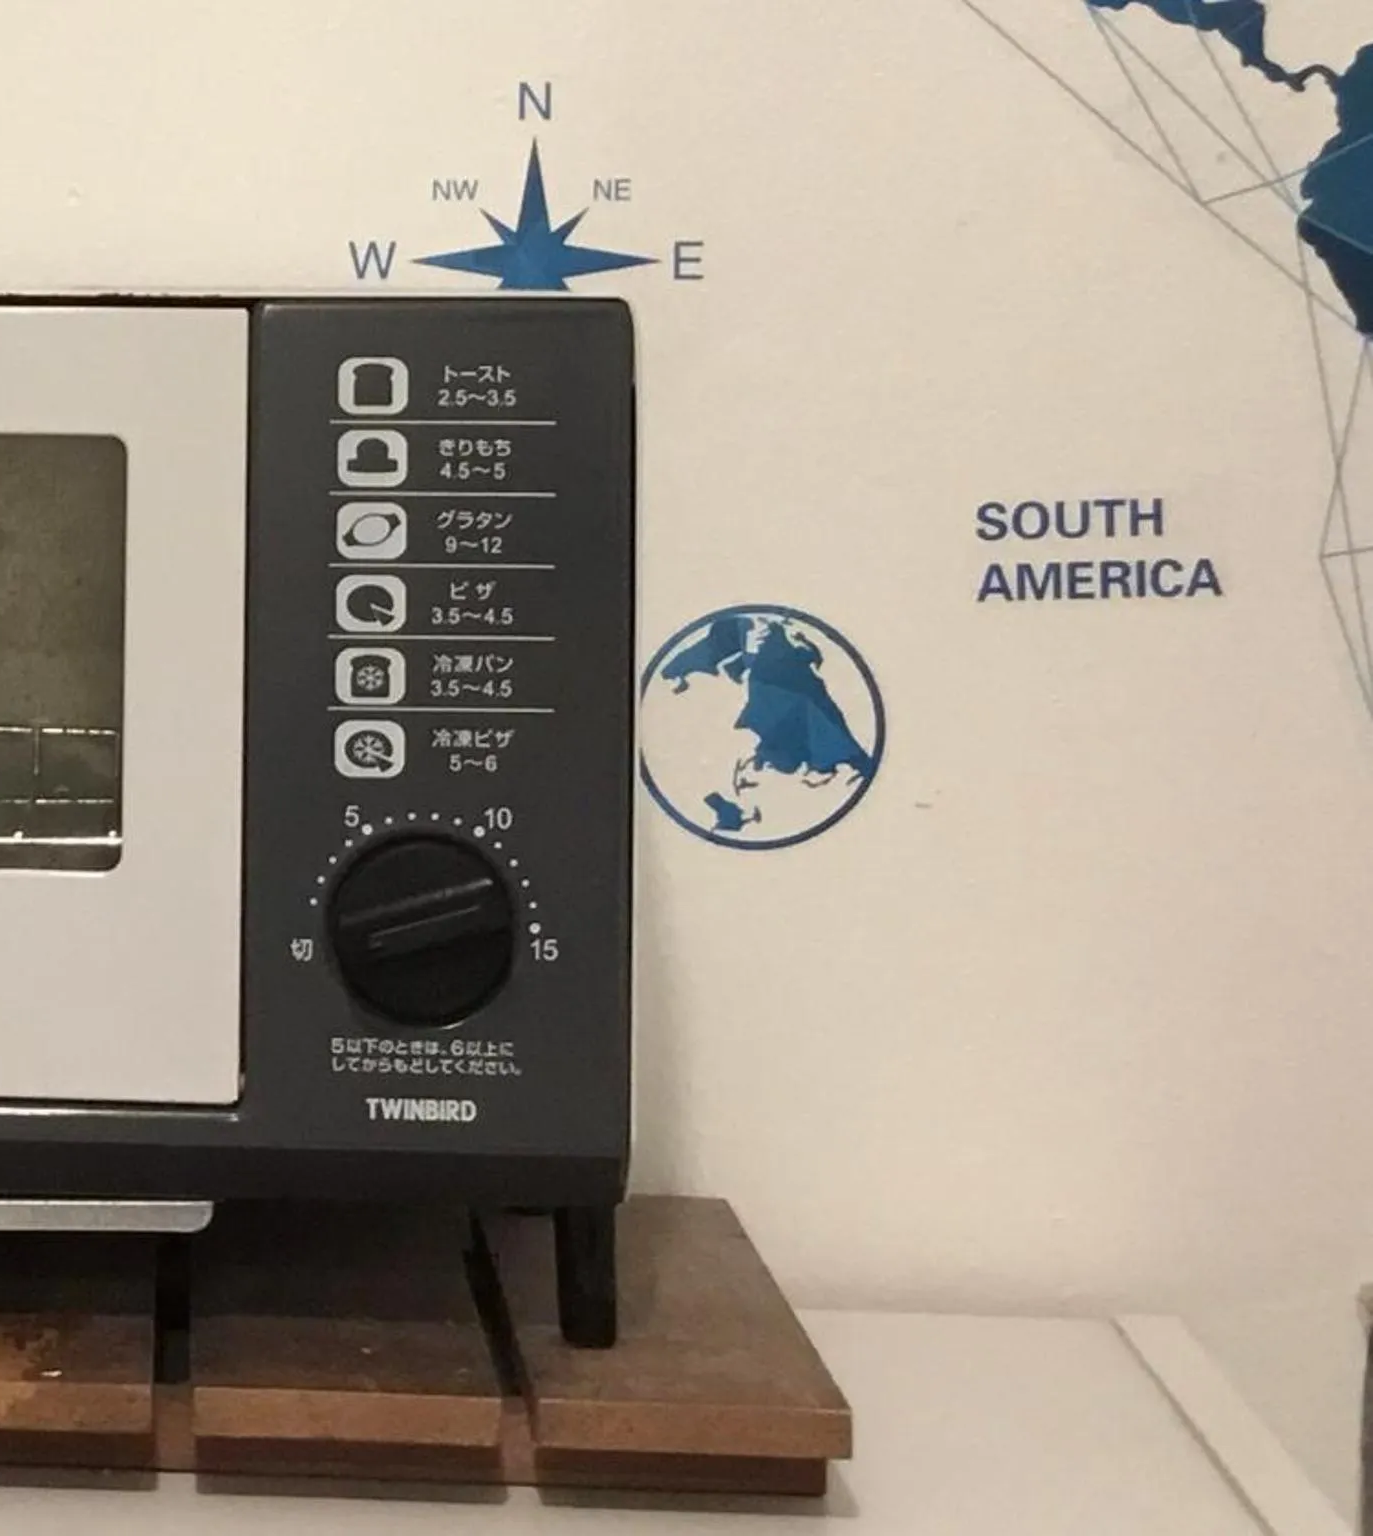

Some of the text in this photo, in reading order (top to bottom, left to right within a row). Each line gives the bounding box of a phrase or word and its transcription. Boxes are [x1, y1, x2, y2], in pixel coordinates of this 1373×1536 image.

[518, 81, 552, 121] N
[432, 179, 479, 201] NW
[592, 178, 632, 202] NE
[348, 240, 397, 281] W
[673, 240, 705, 281] E
[443, 365, 511, 384] トースト
[438, 438, 512, 457] きりもち
[437, 509, 513, 530] グラタン
[975, 497, 1164, 542] SOUTH
[977, 558, 1224, 603] AMERICA
[344, 804, 360, 827] 5
[484, 807, 513, 830] 10
[289, 938, 314, 962] 切
[530, 938, 559, 962] 15
[365, 1097, 478, 1123] TWINBIRD
